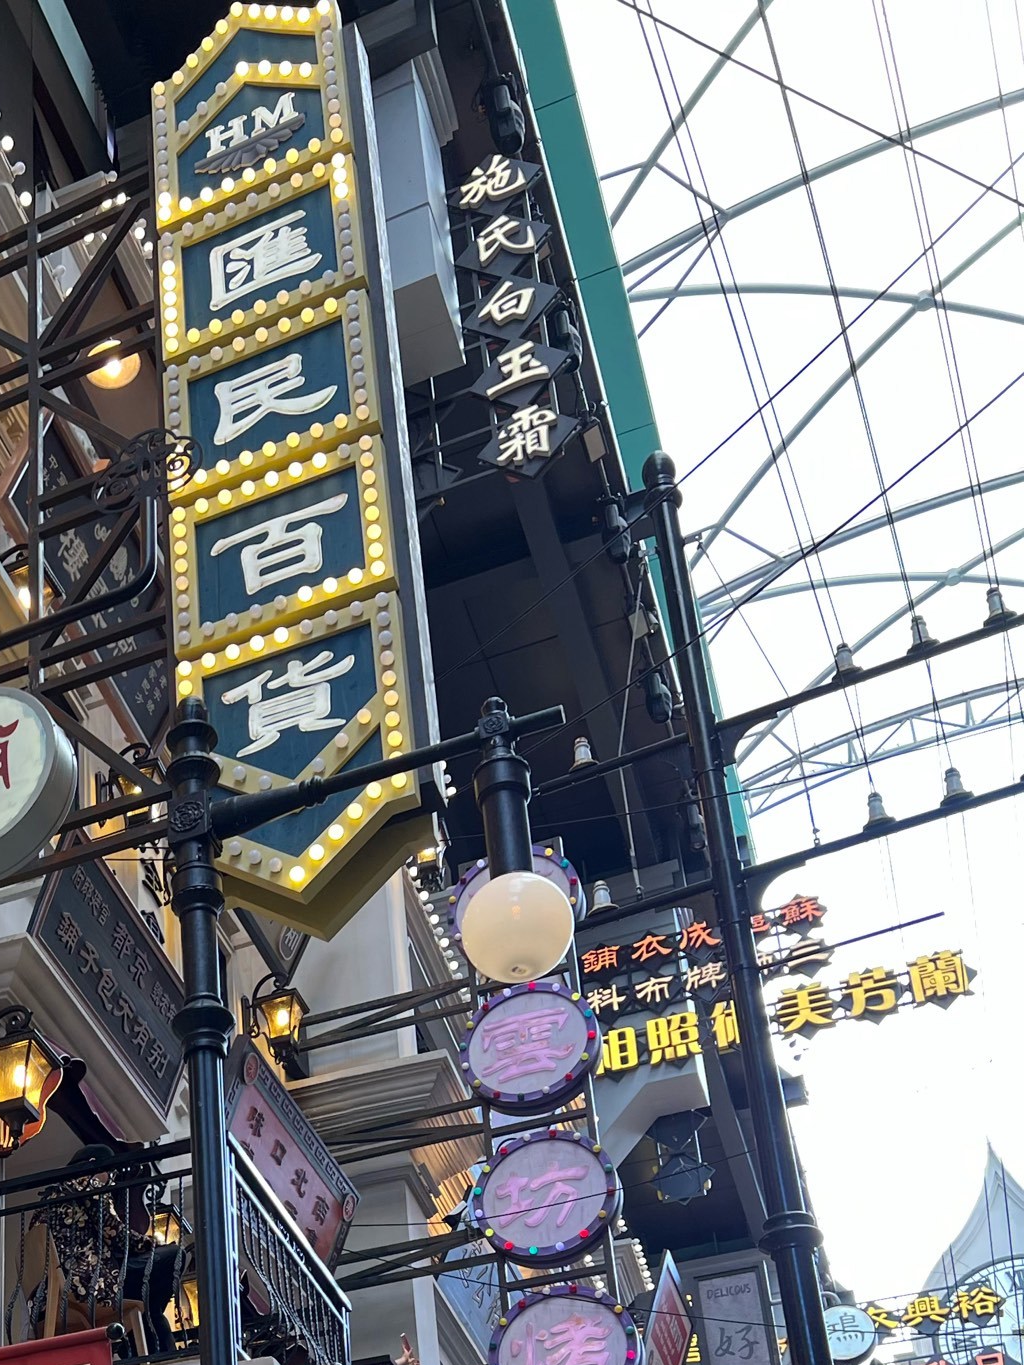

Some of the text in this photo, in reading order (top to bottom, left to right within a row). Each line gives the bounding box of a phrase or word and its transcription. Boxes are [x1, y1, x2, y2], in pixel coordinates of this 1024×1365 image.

[205, 91, 299, 159] HM
[460, 155, 558, 465] 施氏白玉霜
[208, 208, 355, 758] 匯民百貨
